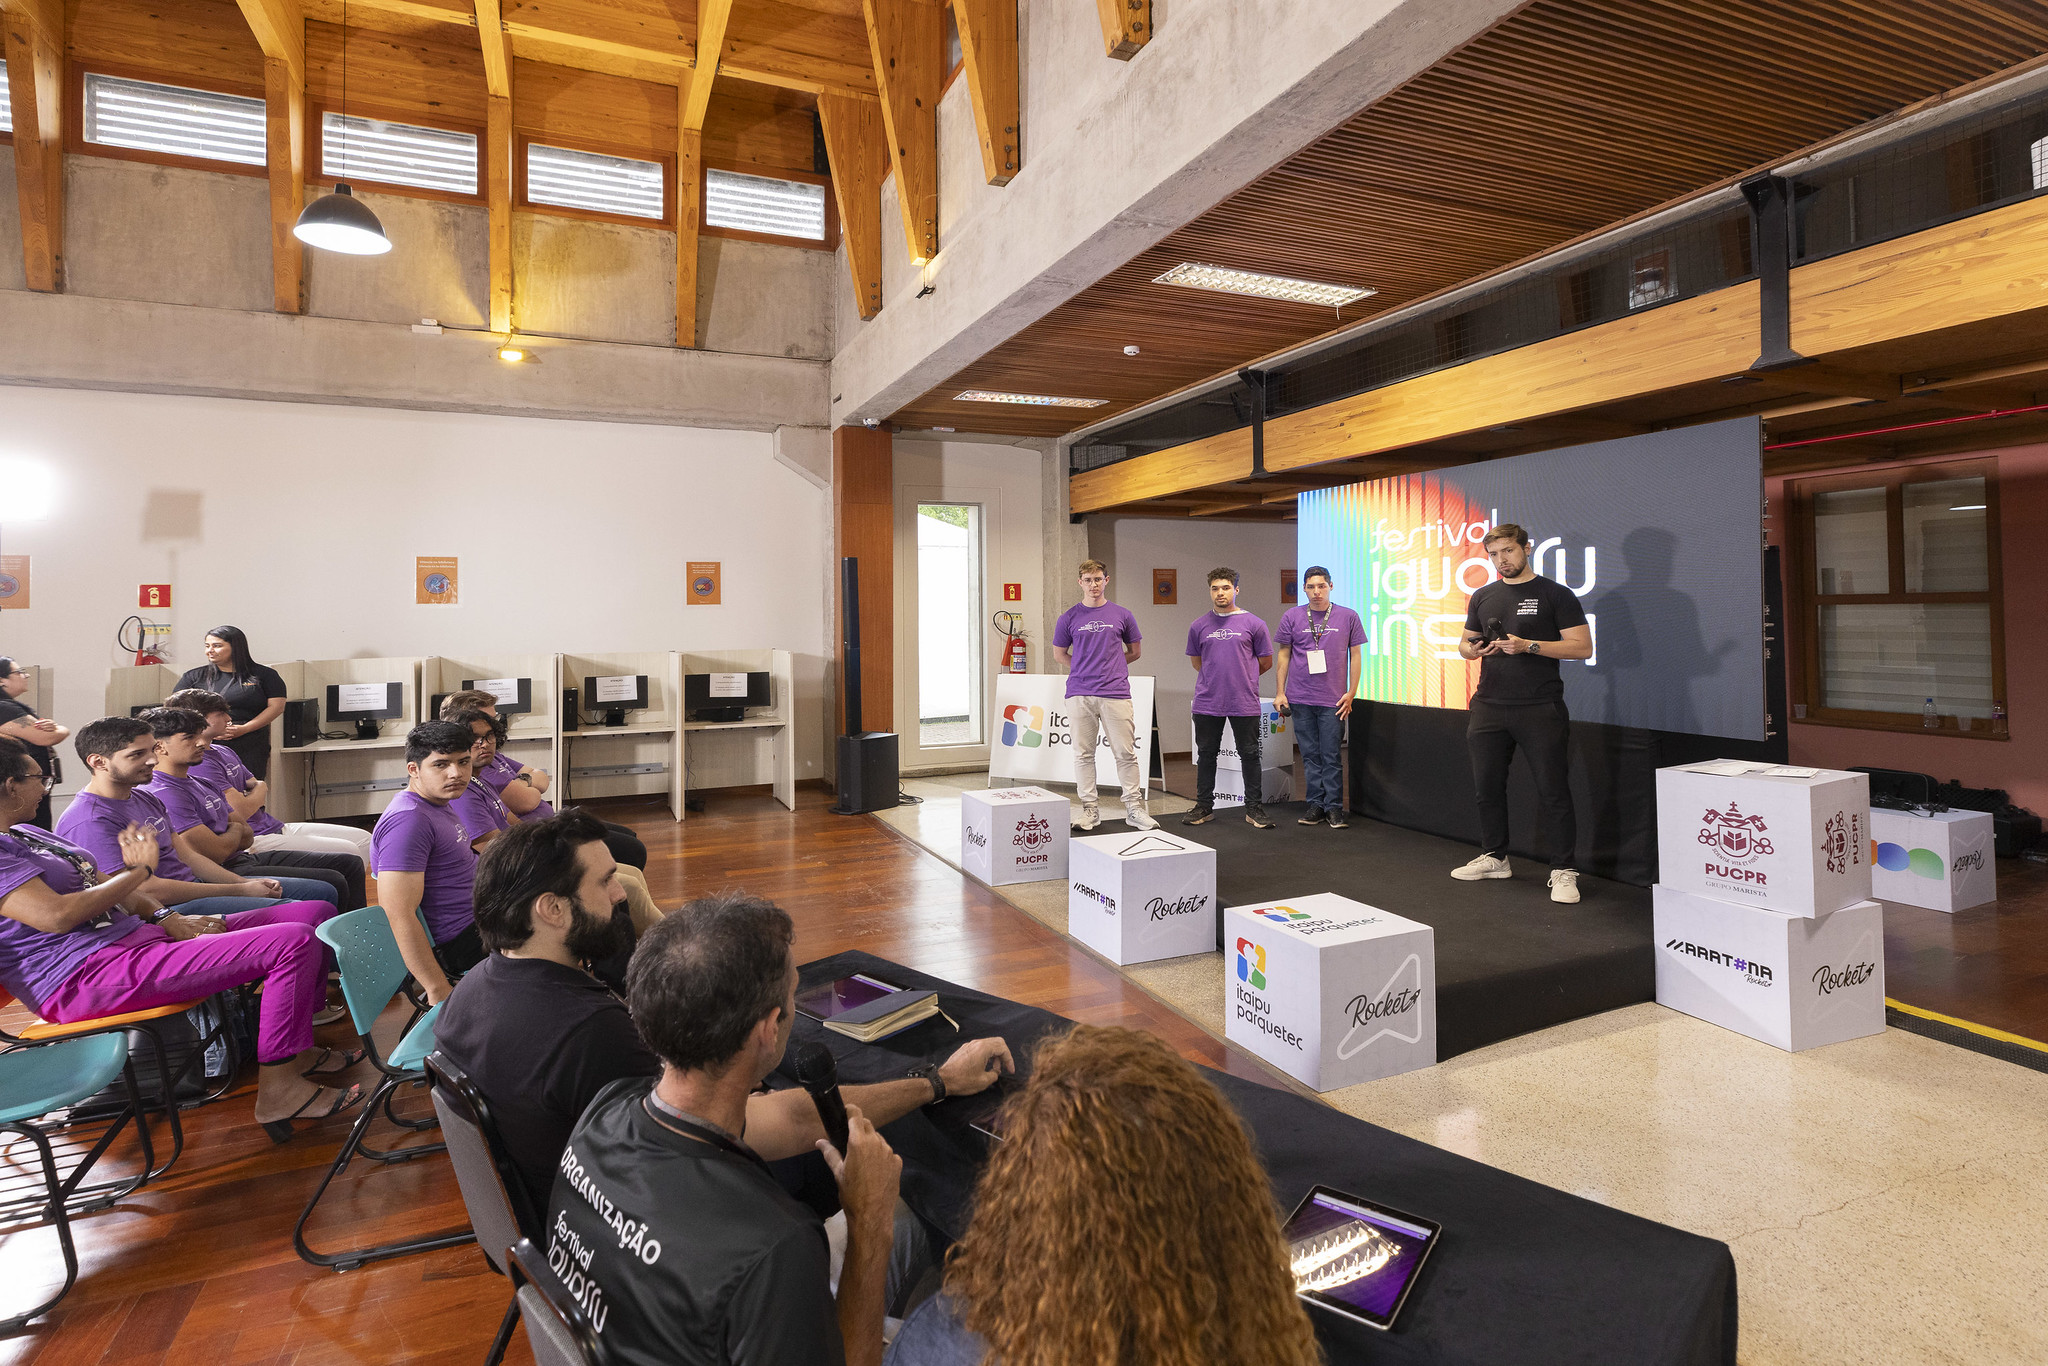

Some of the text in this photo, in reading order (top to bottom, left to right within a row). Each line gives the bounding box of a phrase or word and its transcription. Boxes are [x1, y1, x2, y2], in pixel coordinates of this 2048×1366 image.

[1370, 508, 1498, 554] festival
[1851, 813, 1860, 865] PUCPR
[1015, 854, 1048, 865] PUCPR
[1705, 862, 1767, 886] PUCPR
[1705, 881, 1768, 898] GRUPO MARISTA
[1144, 895, 1203, 922] Rocket
[1283, 918, 1333, 930] itaipu
[1299, 917, 1383, 936] parquetec
[1743, 973, 1770, 988] Rocket
[1812, 961, 1868, 996] Rocket
[1236, 983, 1271, 1015] itaipu
[1345, 988, 1412, 1029] Rocket
[1236, 1004, 1304, 1051] parquetec
[560, 1145, 662, 1265] ORGANIZAÇÃO
[554, 1209, 595, 1272] festival
